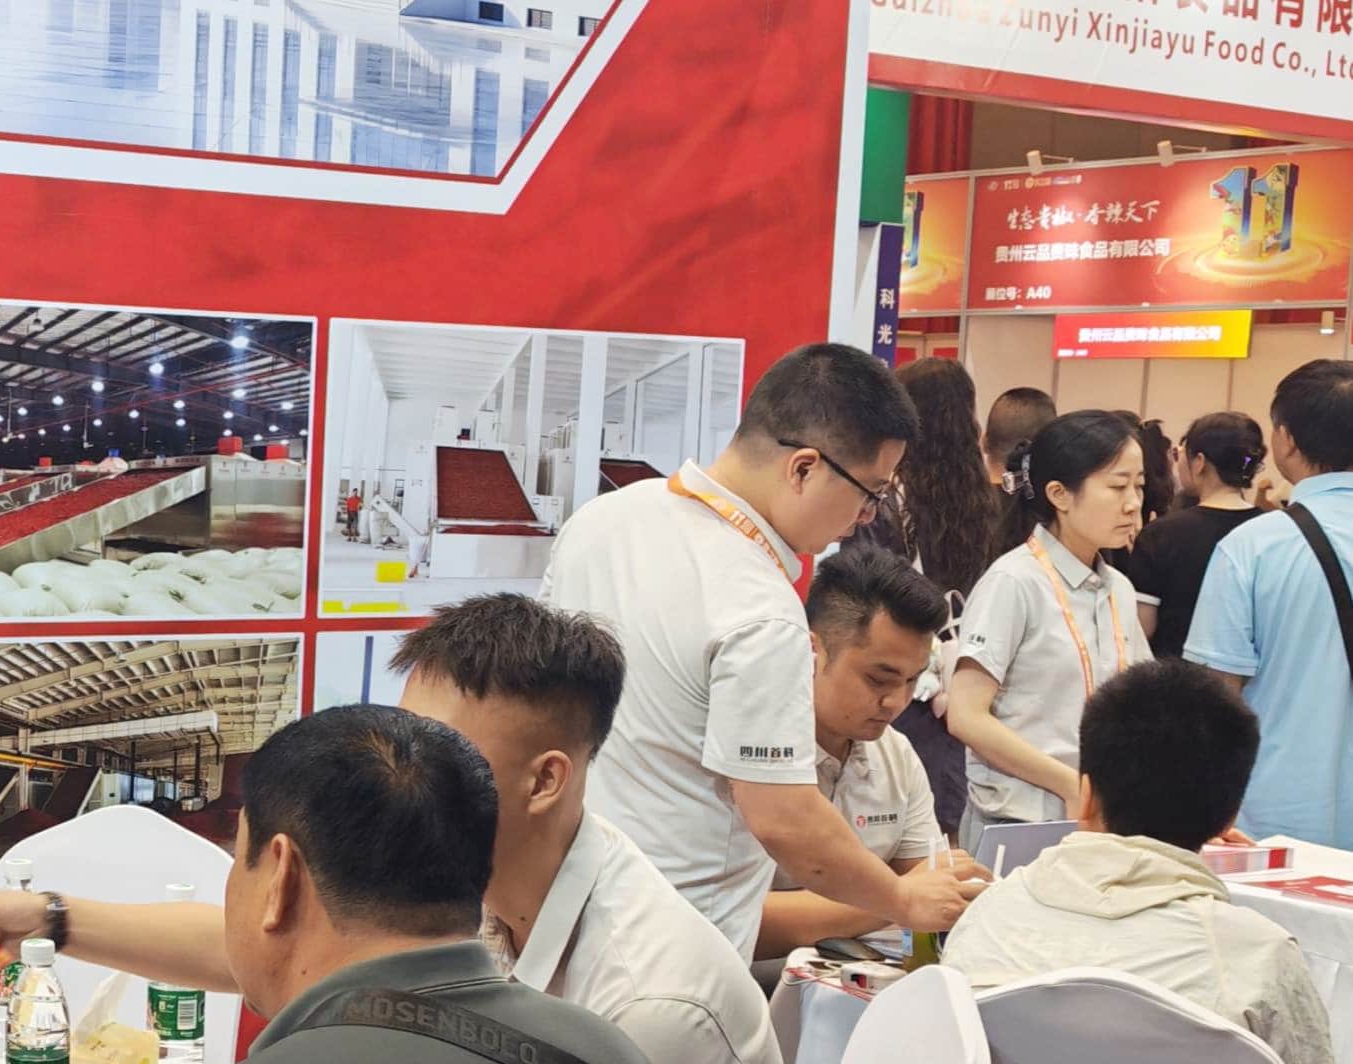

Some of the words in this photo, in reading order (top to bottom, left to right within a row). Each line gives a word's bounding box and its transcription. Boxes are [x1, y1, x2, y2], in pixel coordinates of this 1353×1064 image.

[1086, 11, 1195, 60] Xinjiayu
[1204, 30, 1264, 65] Food
[1272, 41, 1317, 78] Co.,
[1026, 285, 1052, 300] A40
[877, 288, 895, 367] 科光
